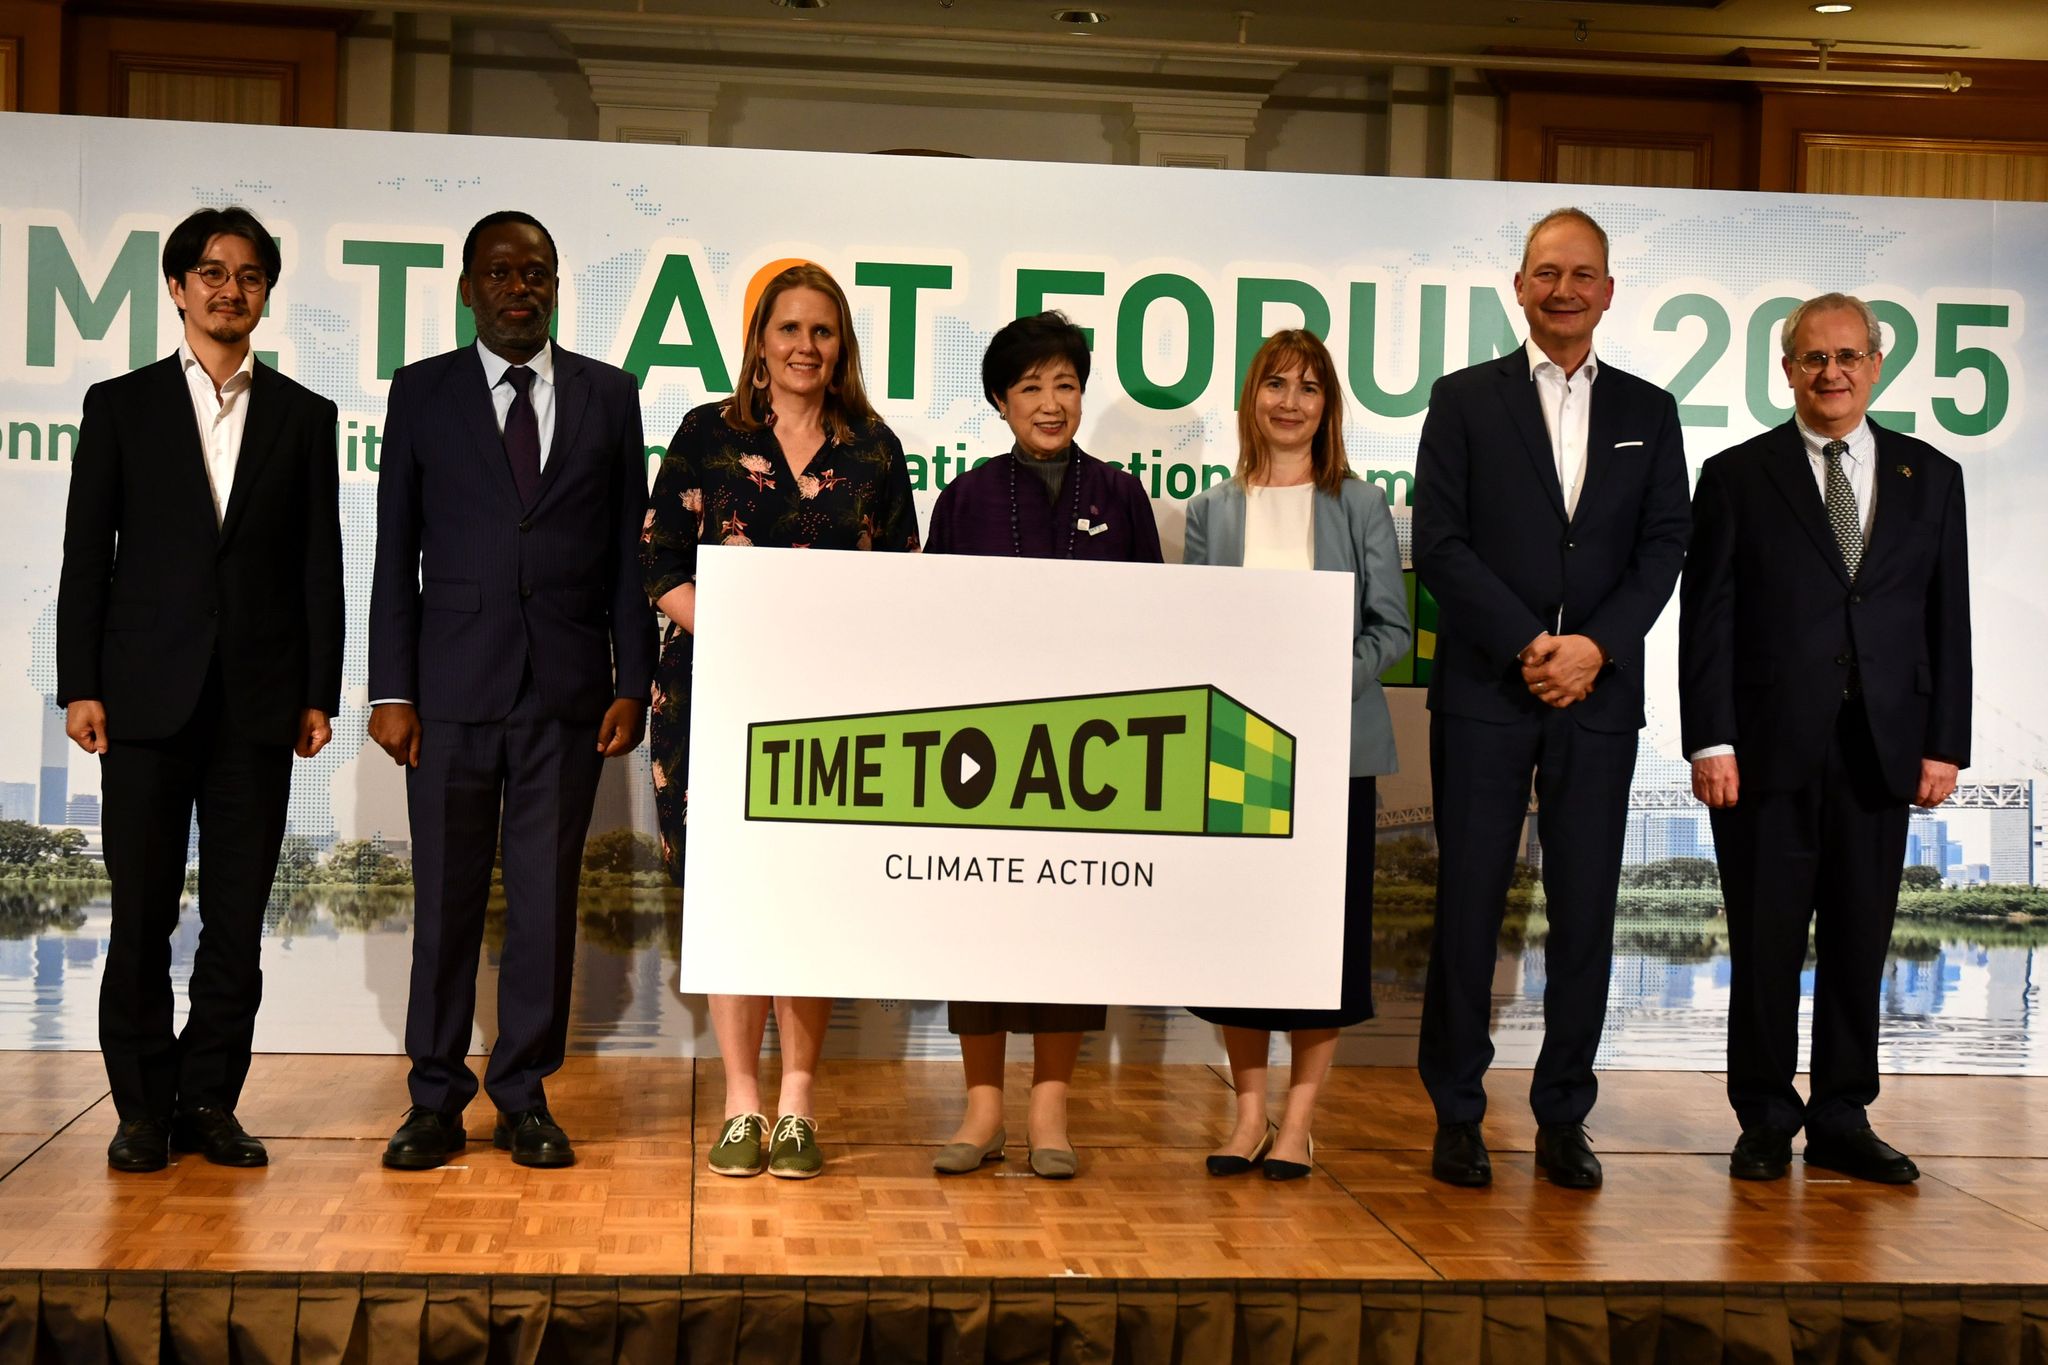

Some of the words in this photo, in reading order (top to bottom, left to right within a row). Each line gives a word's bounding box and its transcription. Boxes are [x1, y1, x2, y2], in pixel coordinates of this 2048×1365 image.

[1652, 292, 2011, 437] 2025
[762, 733, 886, 807] TIME
[902, 726, 997, 810] TO
[1009, 714, 1187, 812] ACT
[885, 854, 1025, 884] CLIMATE
[1036, 859, 1153, 888] ACTION
